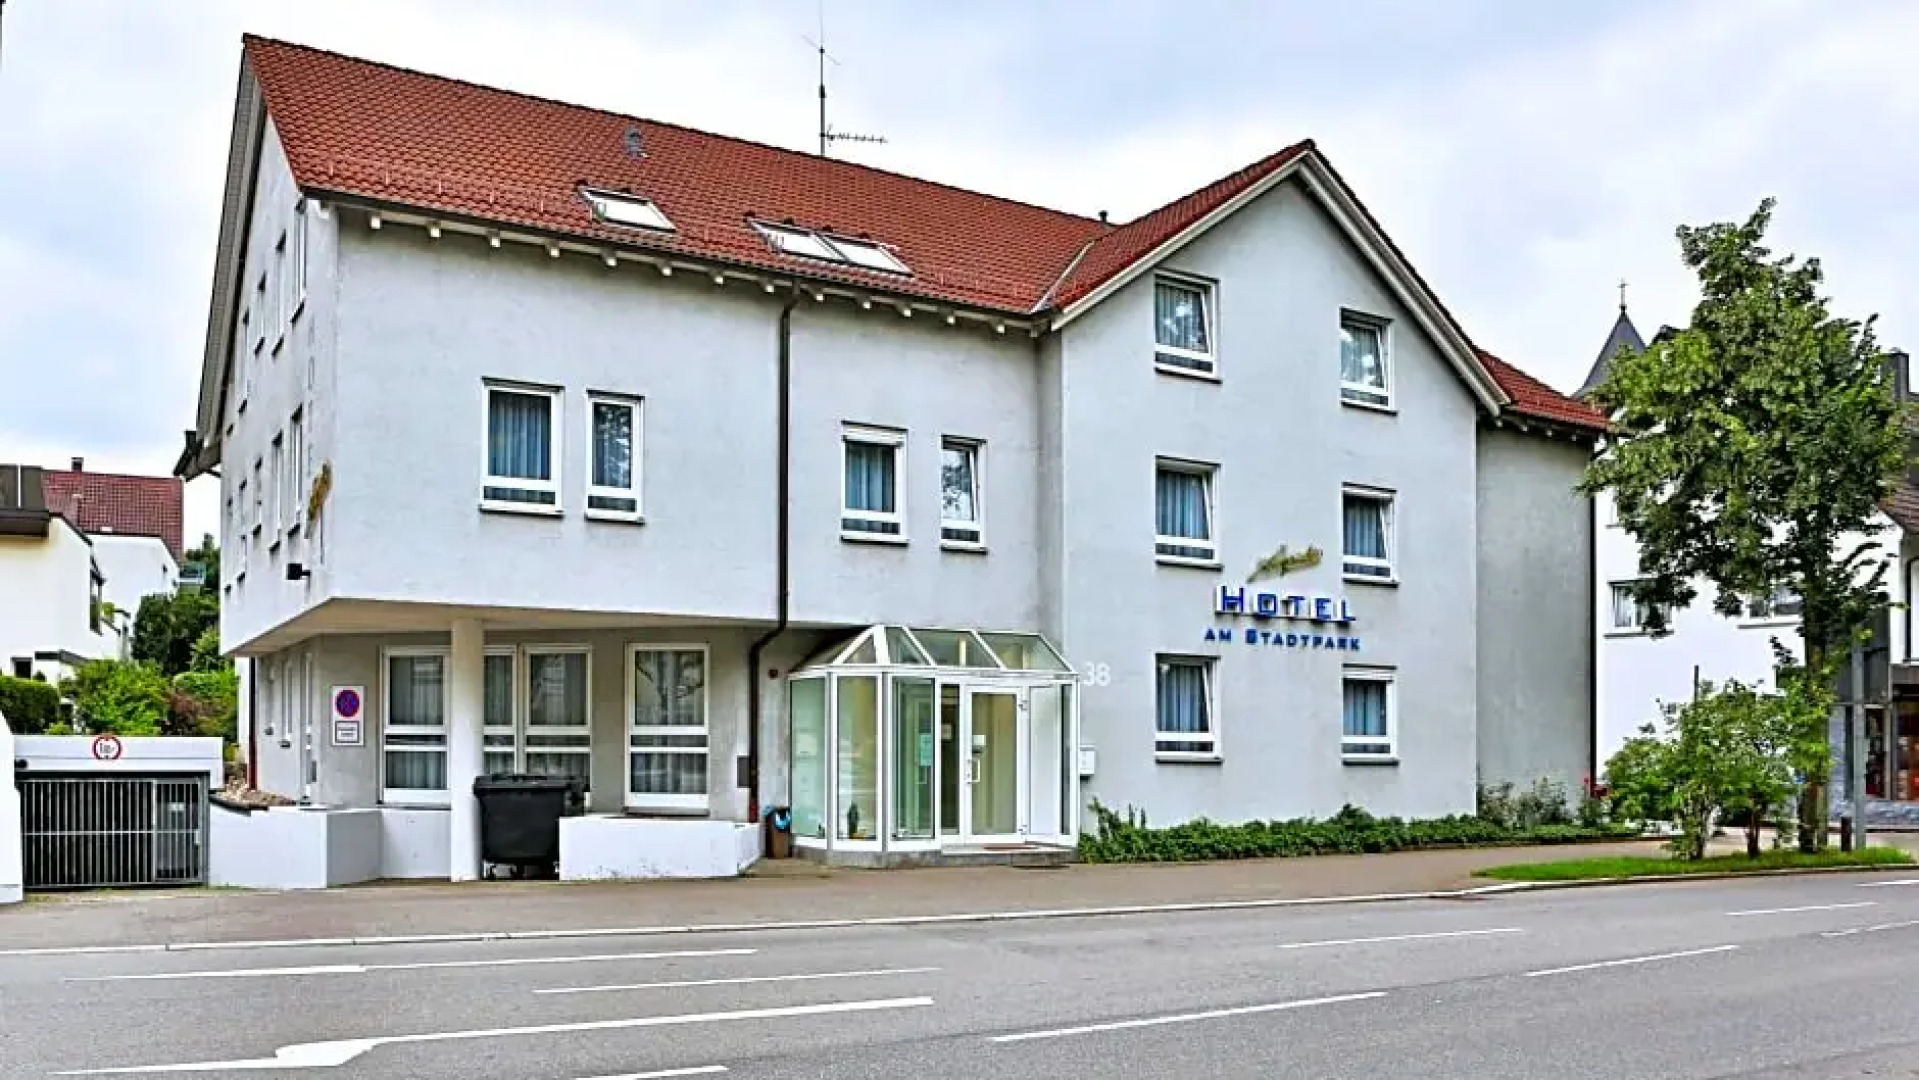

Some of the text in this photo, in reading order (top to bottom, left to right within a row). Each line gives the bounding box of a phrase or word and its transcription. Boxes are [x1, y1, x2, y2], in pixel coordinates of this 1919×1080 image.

[1215, 585, 1356, 621] HOTEL
[1204, 628, 1361, 651] AM STADTPARK
[1083, 661, 1112, 687] 38
